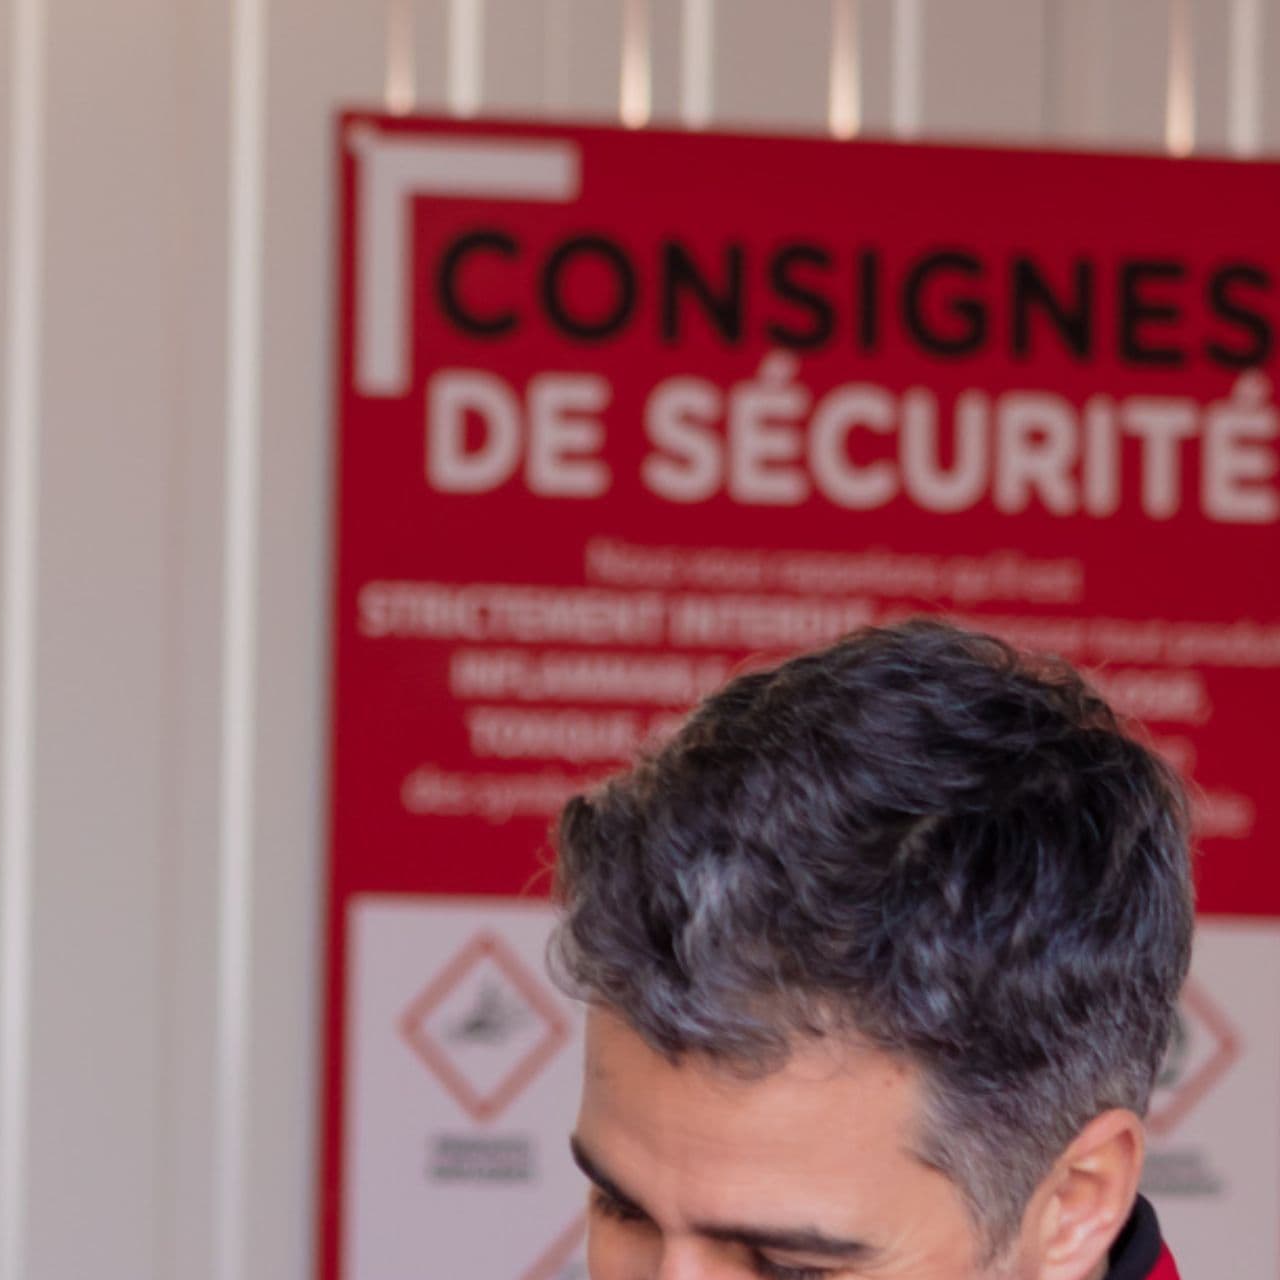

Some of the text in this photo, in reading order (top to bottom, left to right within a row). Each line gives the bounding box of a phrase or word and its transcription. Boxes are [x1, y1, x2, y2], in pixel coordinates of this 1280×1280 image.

[436, 228, 1273, 372] CONSIGNES
[426, 350, 1278, 524] DE SÉCURITÉ
